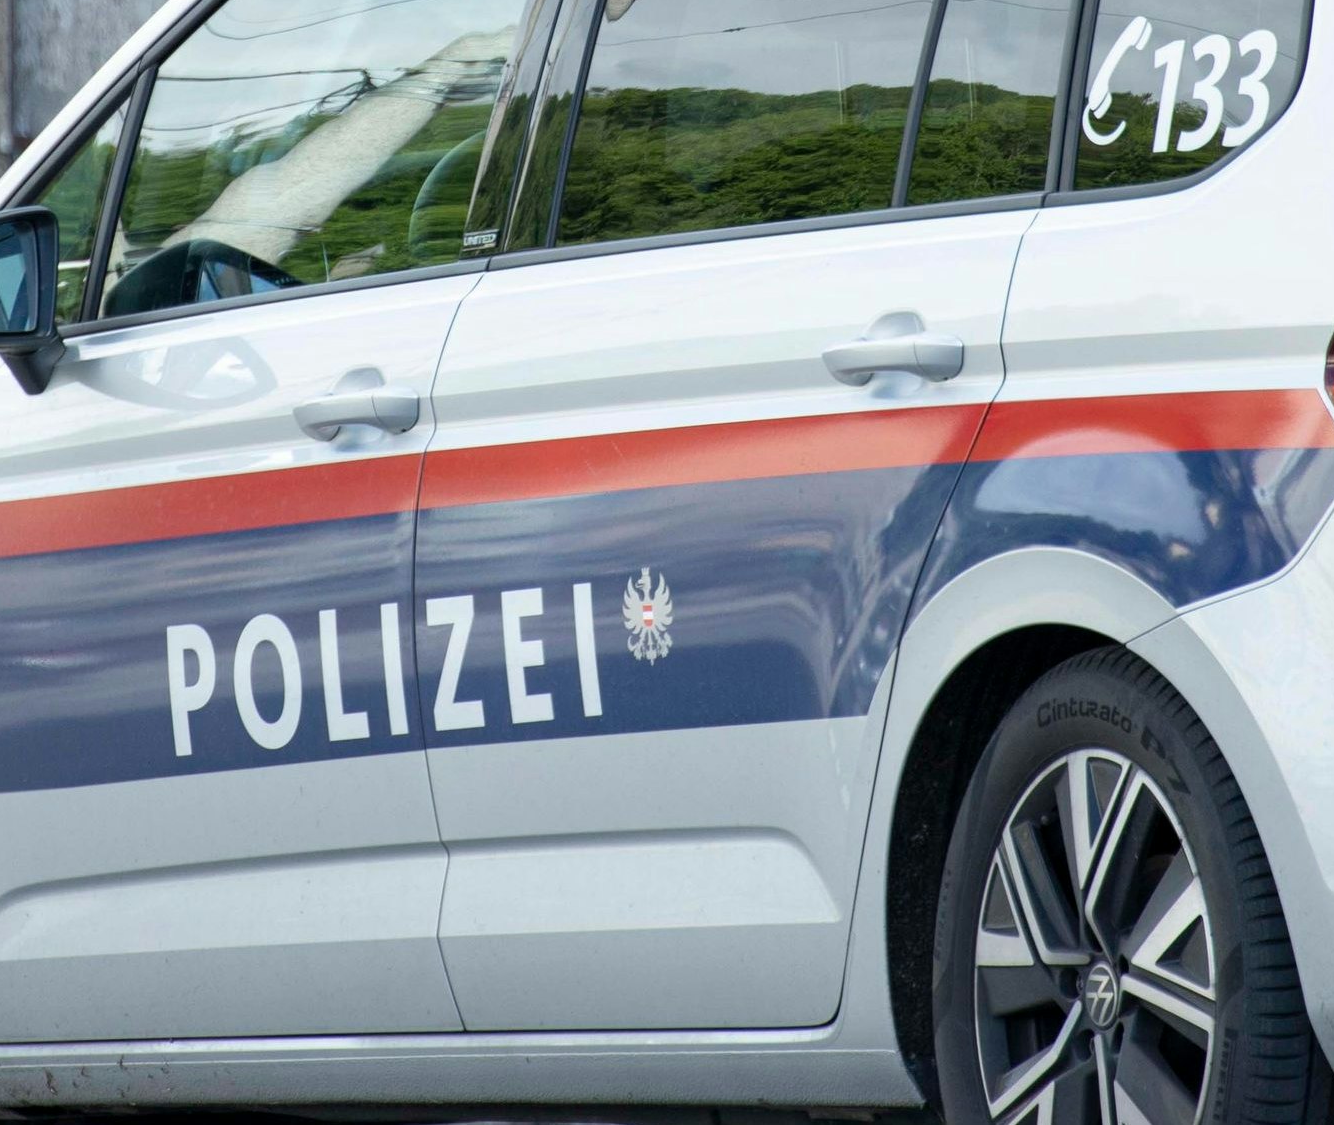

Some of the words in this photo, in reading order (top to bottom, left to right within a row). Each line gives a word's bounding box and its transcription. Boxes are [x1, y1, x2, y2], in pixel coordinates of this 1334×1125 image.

[1152, 29, 1278, 153] 133
[166, 582, 603, 757] POLIZEI
[1036, 697, 1133, 734] Cinturato
[1140, 725, 1191, 795] P7
